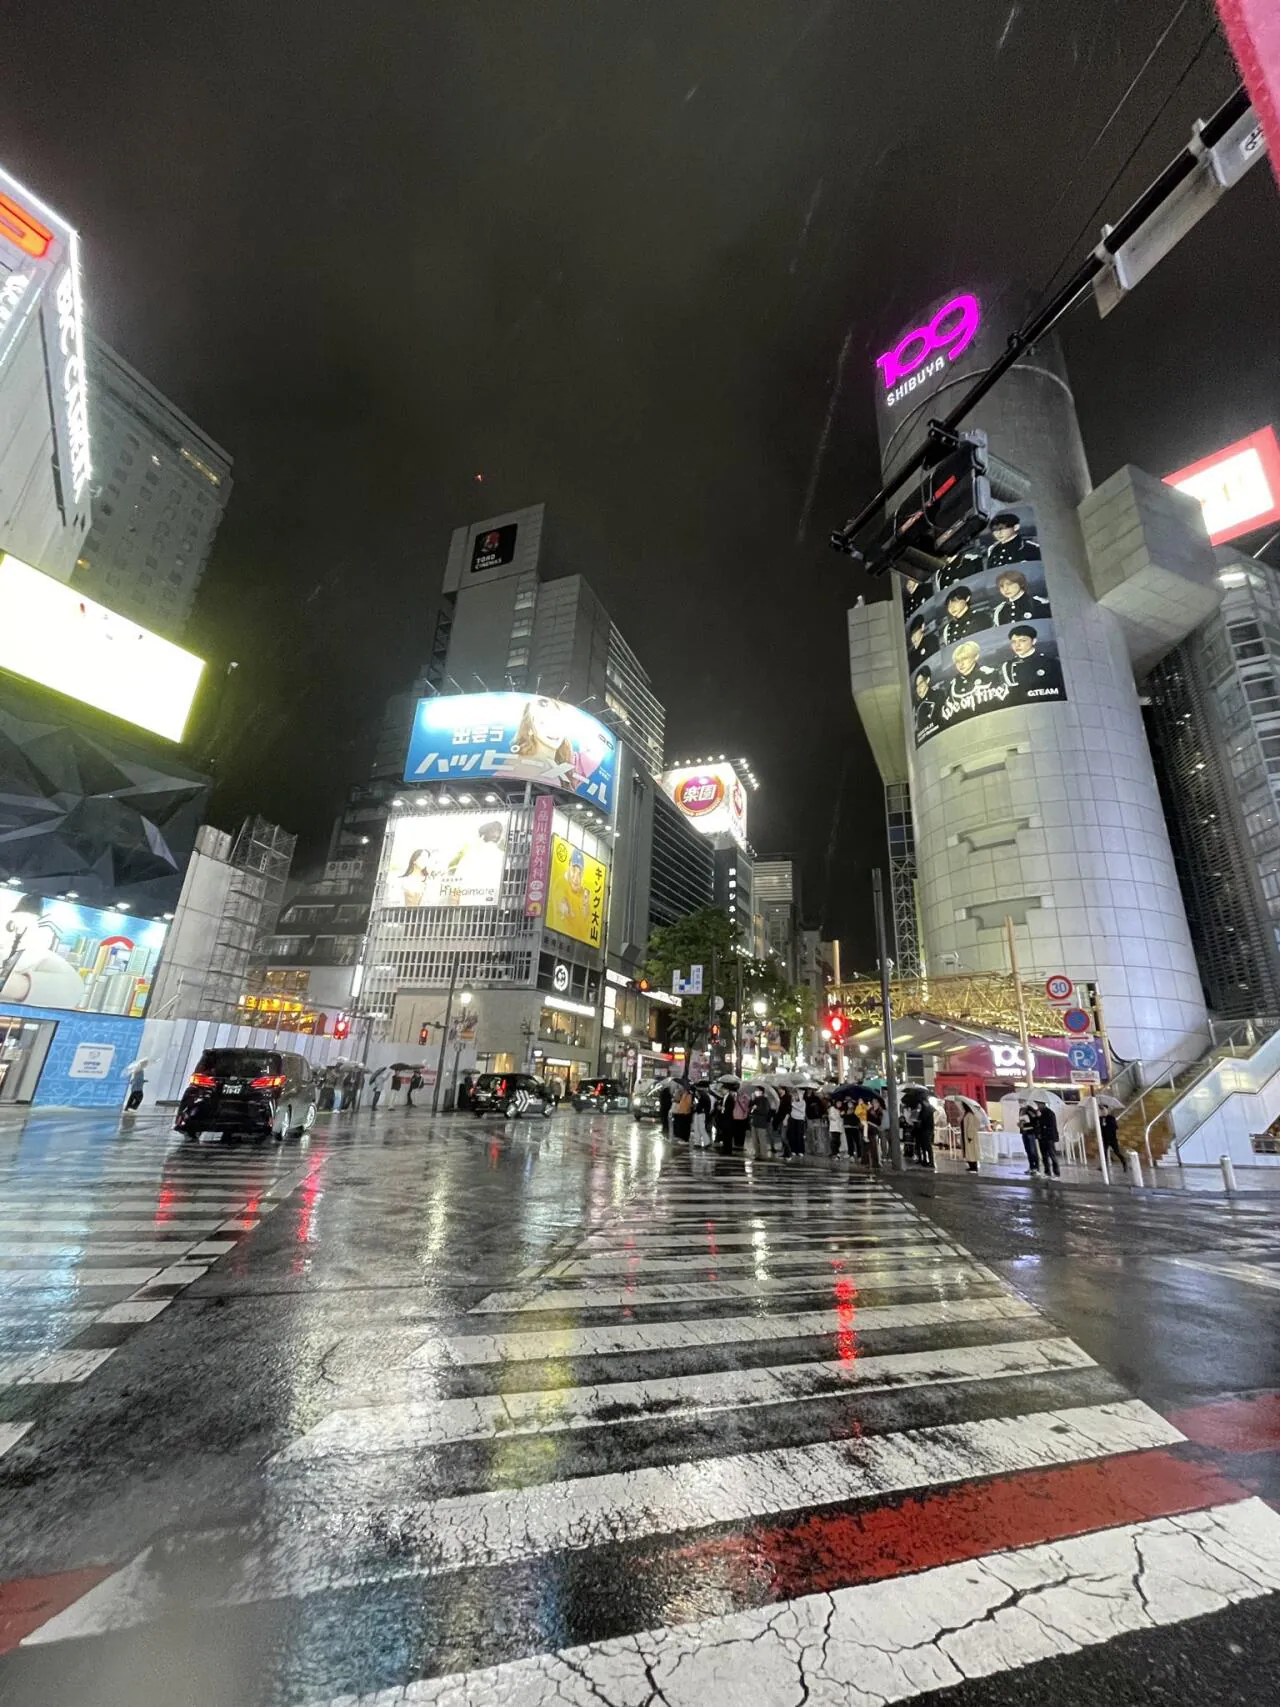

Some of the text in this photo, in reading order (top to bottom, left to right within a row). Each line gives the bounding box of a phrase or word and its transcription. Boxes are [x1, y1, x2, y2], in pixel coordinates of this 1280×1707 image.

[877, 294, 979, 388] 109
[887, 356, 945, 406] SHIBUYA
[414, 746, 608, 805] ハッピーメール
[683, 784, 717, 803] 楽園
[590, 867, 603, 941] キング大山
[1051, 982, 1067, 993] 30
[989, 1044, 1035, 1071] 109
